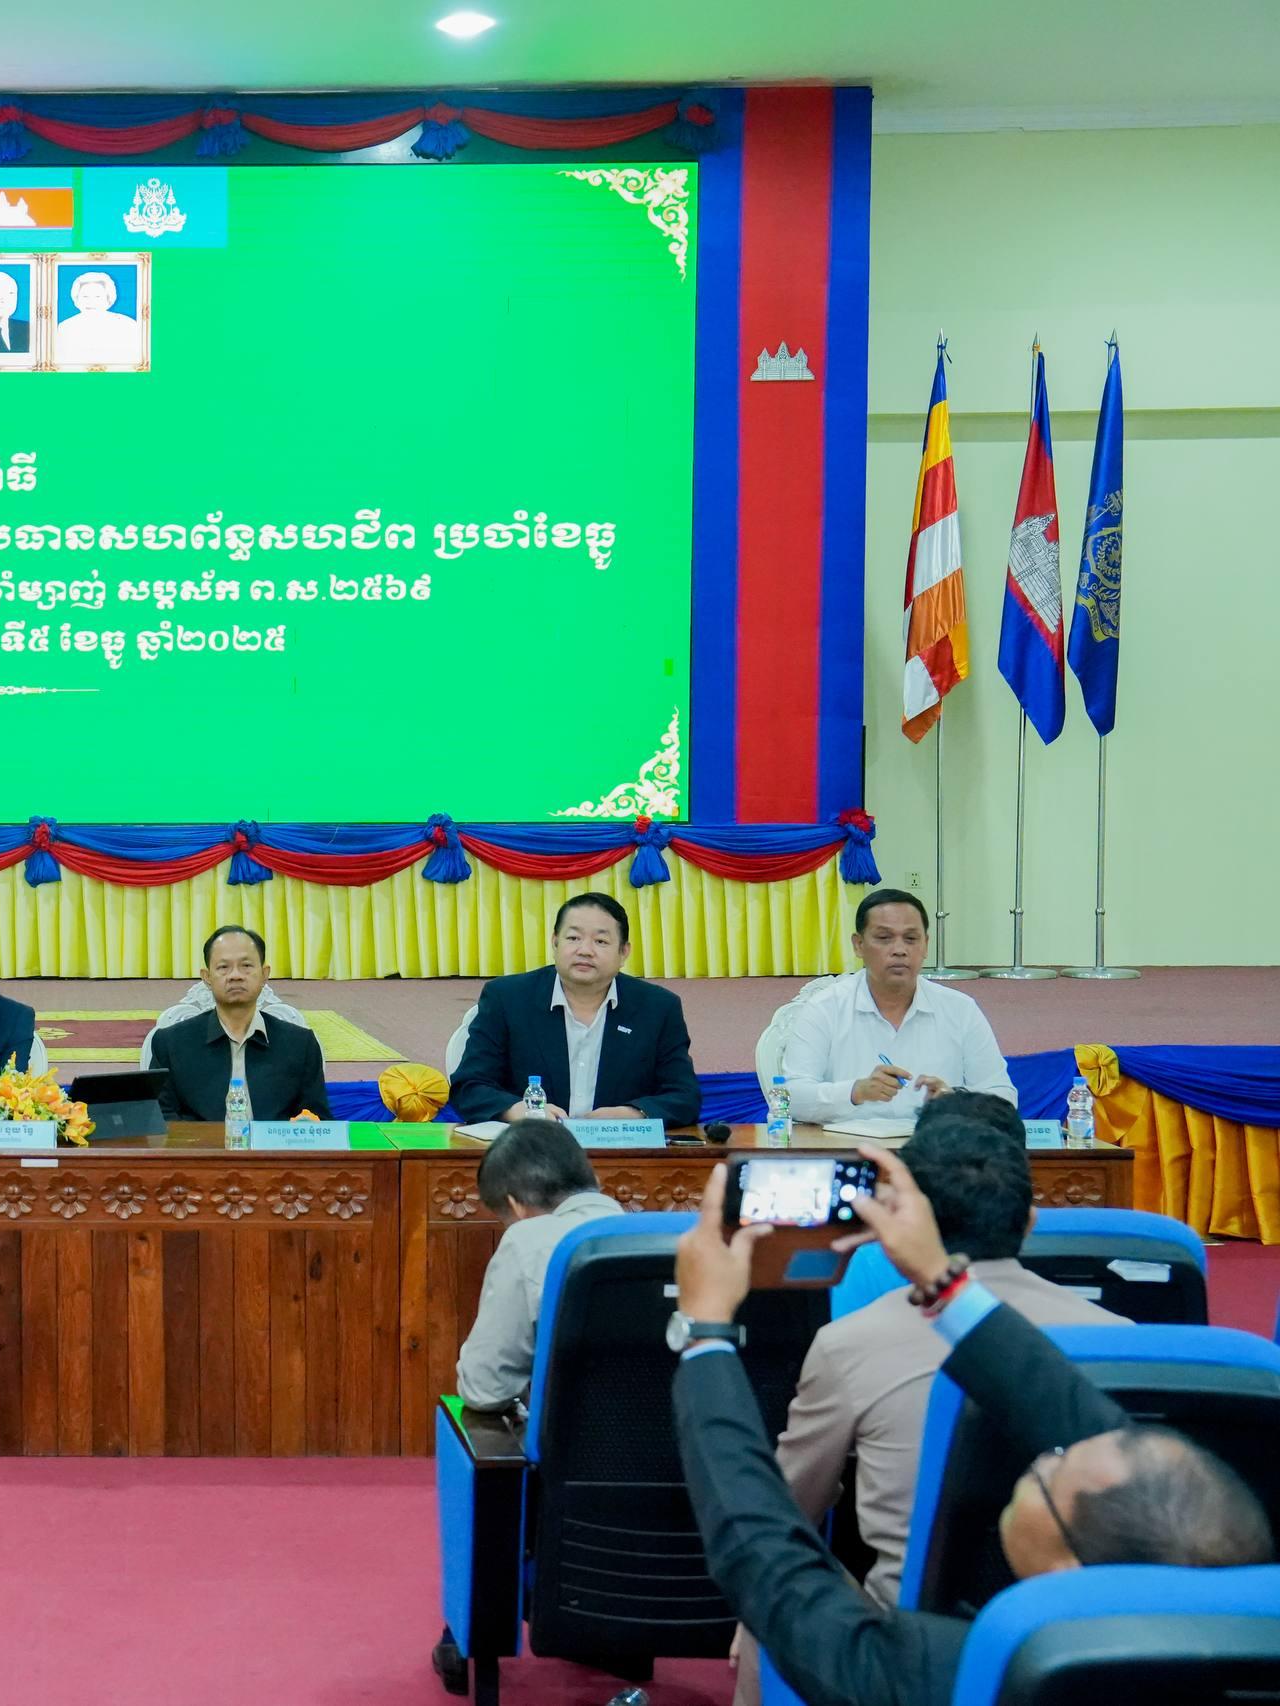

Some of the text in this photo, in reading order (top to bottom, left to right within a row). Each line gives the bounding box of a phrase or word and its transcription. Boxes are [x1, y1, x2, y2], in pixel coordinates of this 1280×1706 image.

[433, 510, 615, 570] ប្រចាំខែធ្នូ
[250, 574, 431, 601] ព.ស.២៥៦៩
[61, 624, 124, 669] ខែធ្នូ
[137, 621, 285, 660] ឆ្នាំ២០២៥
